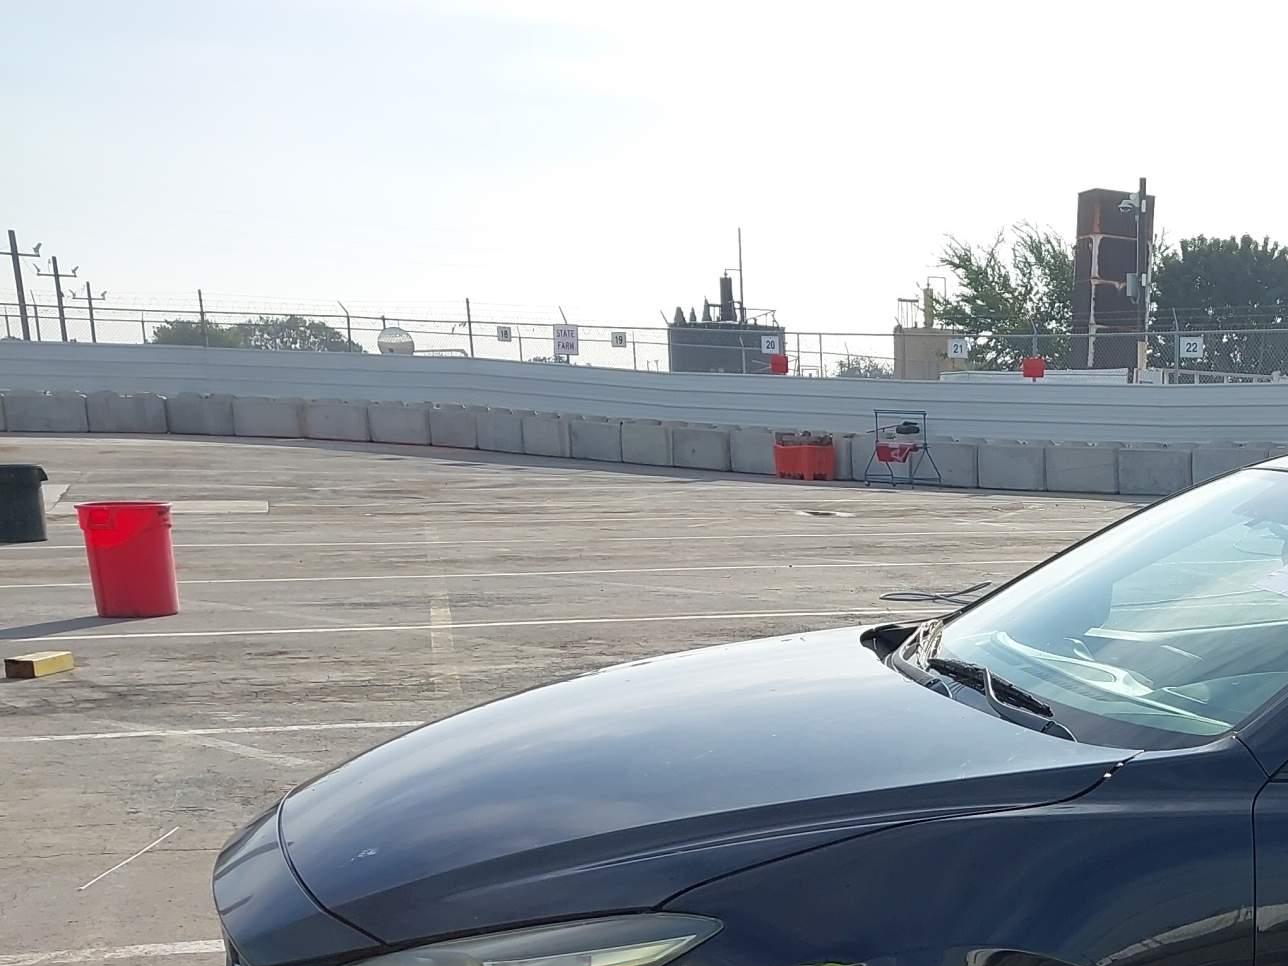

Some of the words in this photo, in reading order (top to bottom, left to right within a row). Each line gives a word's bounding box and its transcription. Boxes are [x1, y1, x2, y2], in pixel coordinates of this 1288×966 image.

[556, 329, 576, 338] STATE
[557, 341, 575, 350] FARM
[766, 340, 776, 350] 20
[952, 343, 963, 354] 21
[1185, 342, 1198, 353] 22
